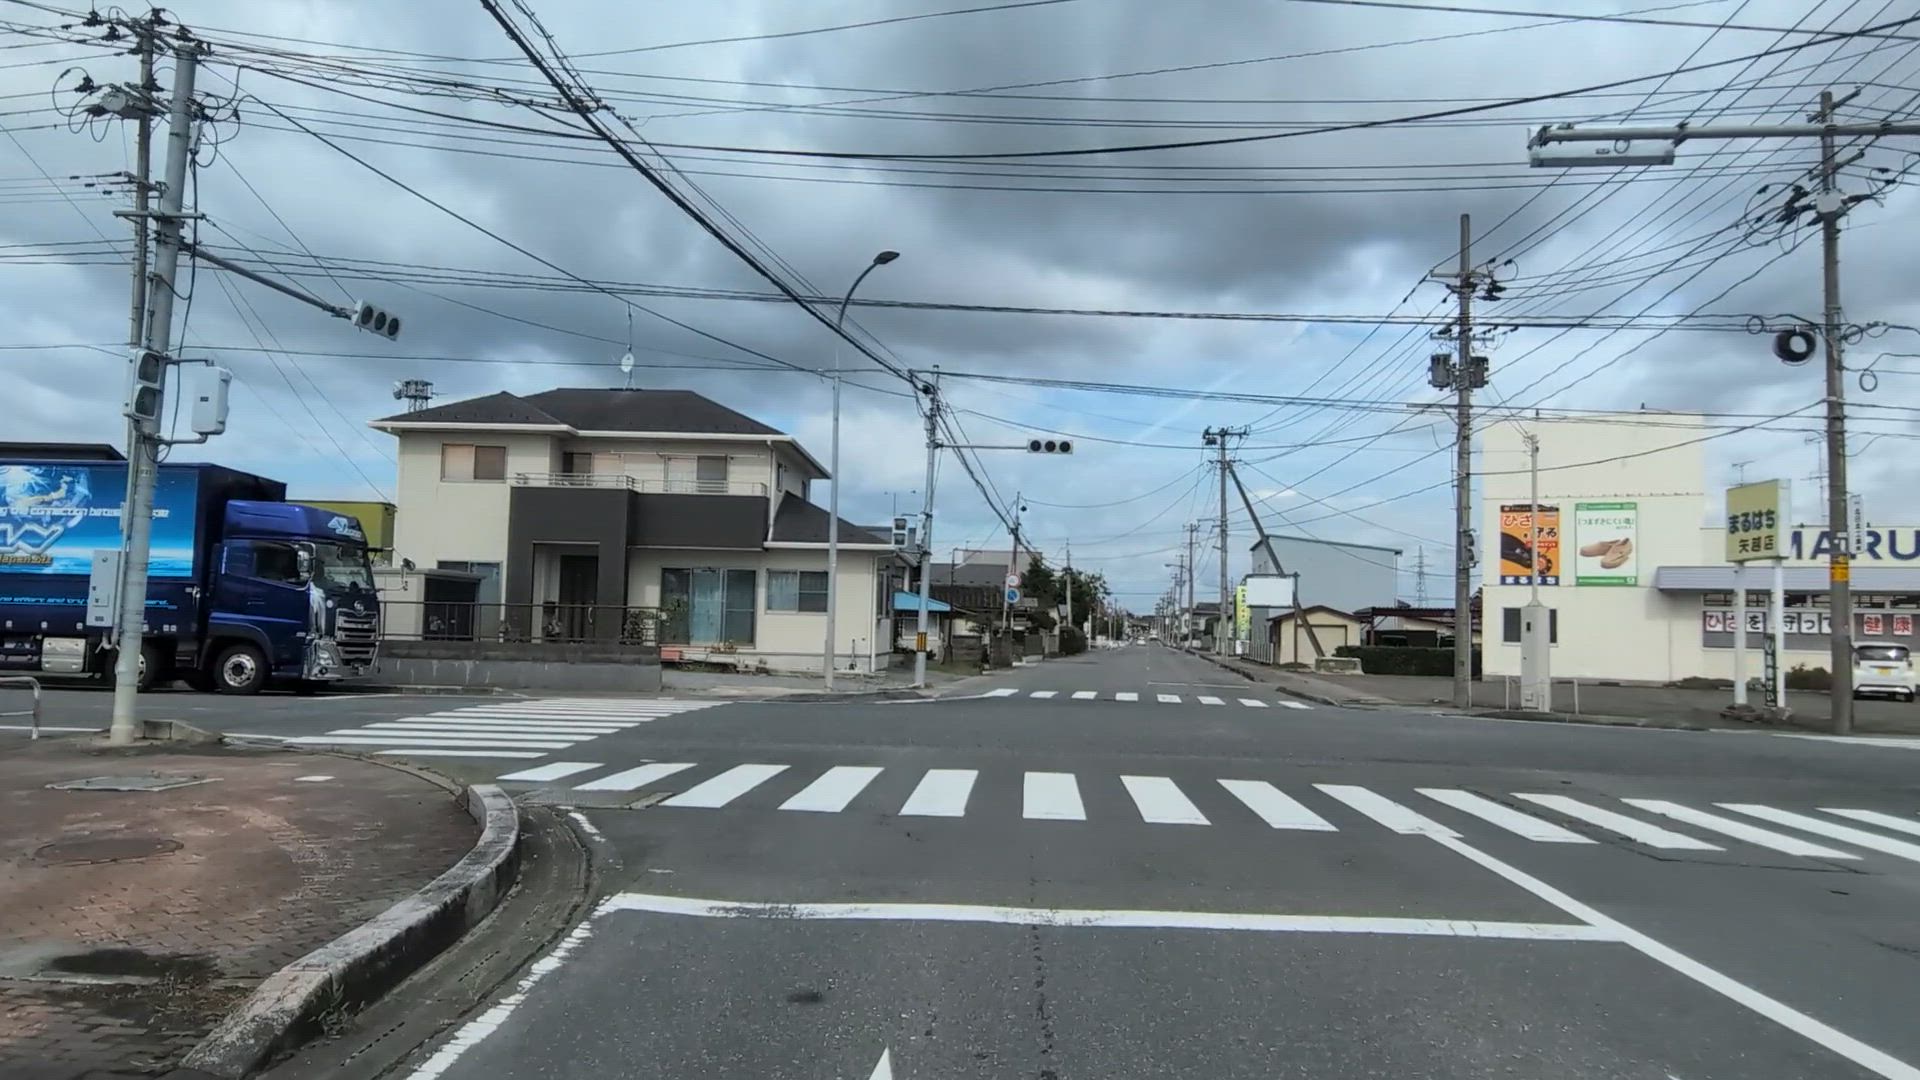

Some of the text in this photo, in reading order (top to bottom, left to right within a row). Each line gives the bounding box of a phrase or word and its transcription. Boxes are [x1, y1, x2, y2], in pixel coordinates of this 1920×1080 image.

[1503, 514, 1532, 527] ひざ
[1728, 508, 1775, 534] まるはち
[1863, 616, 1911, 634] 健康
